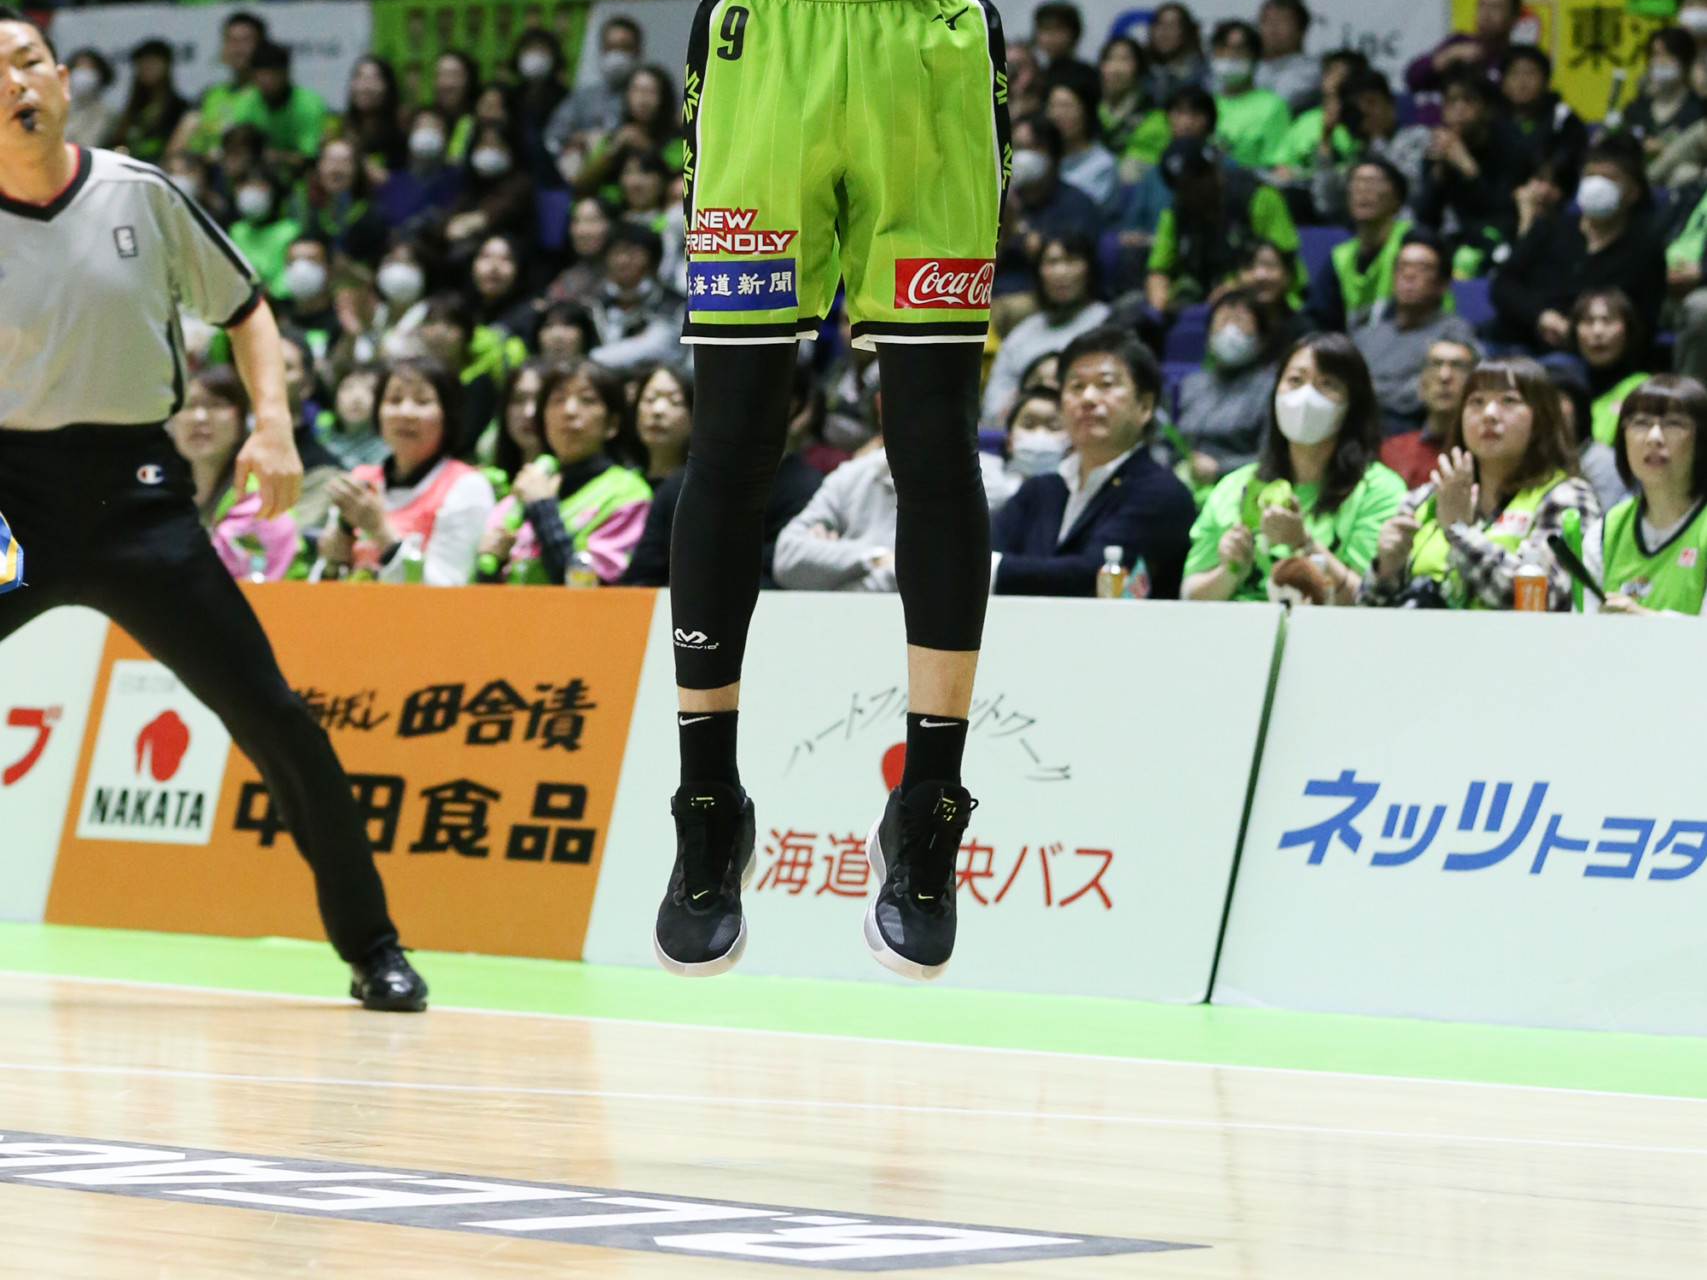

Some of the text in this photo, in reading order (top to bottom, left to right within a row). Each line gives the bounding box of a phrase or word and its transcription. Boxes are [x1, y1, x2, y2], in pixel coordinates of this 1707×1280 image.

[717, 6, 750, 61] 9
[686, 232, 792, 252] FRIENDLY
[697, 210, 754, 230] NEW
[396, 678, 598, 752] 田舎漬
[91, 786, 206, 832] NAKATA
[1277, 769, 1707, 881] ネッツトヨタ
[755, 827, 1115, 911] 海道央バス
[0, 1141, 1084, 1262] B.LEAG
